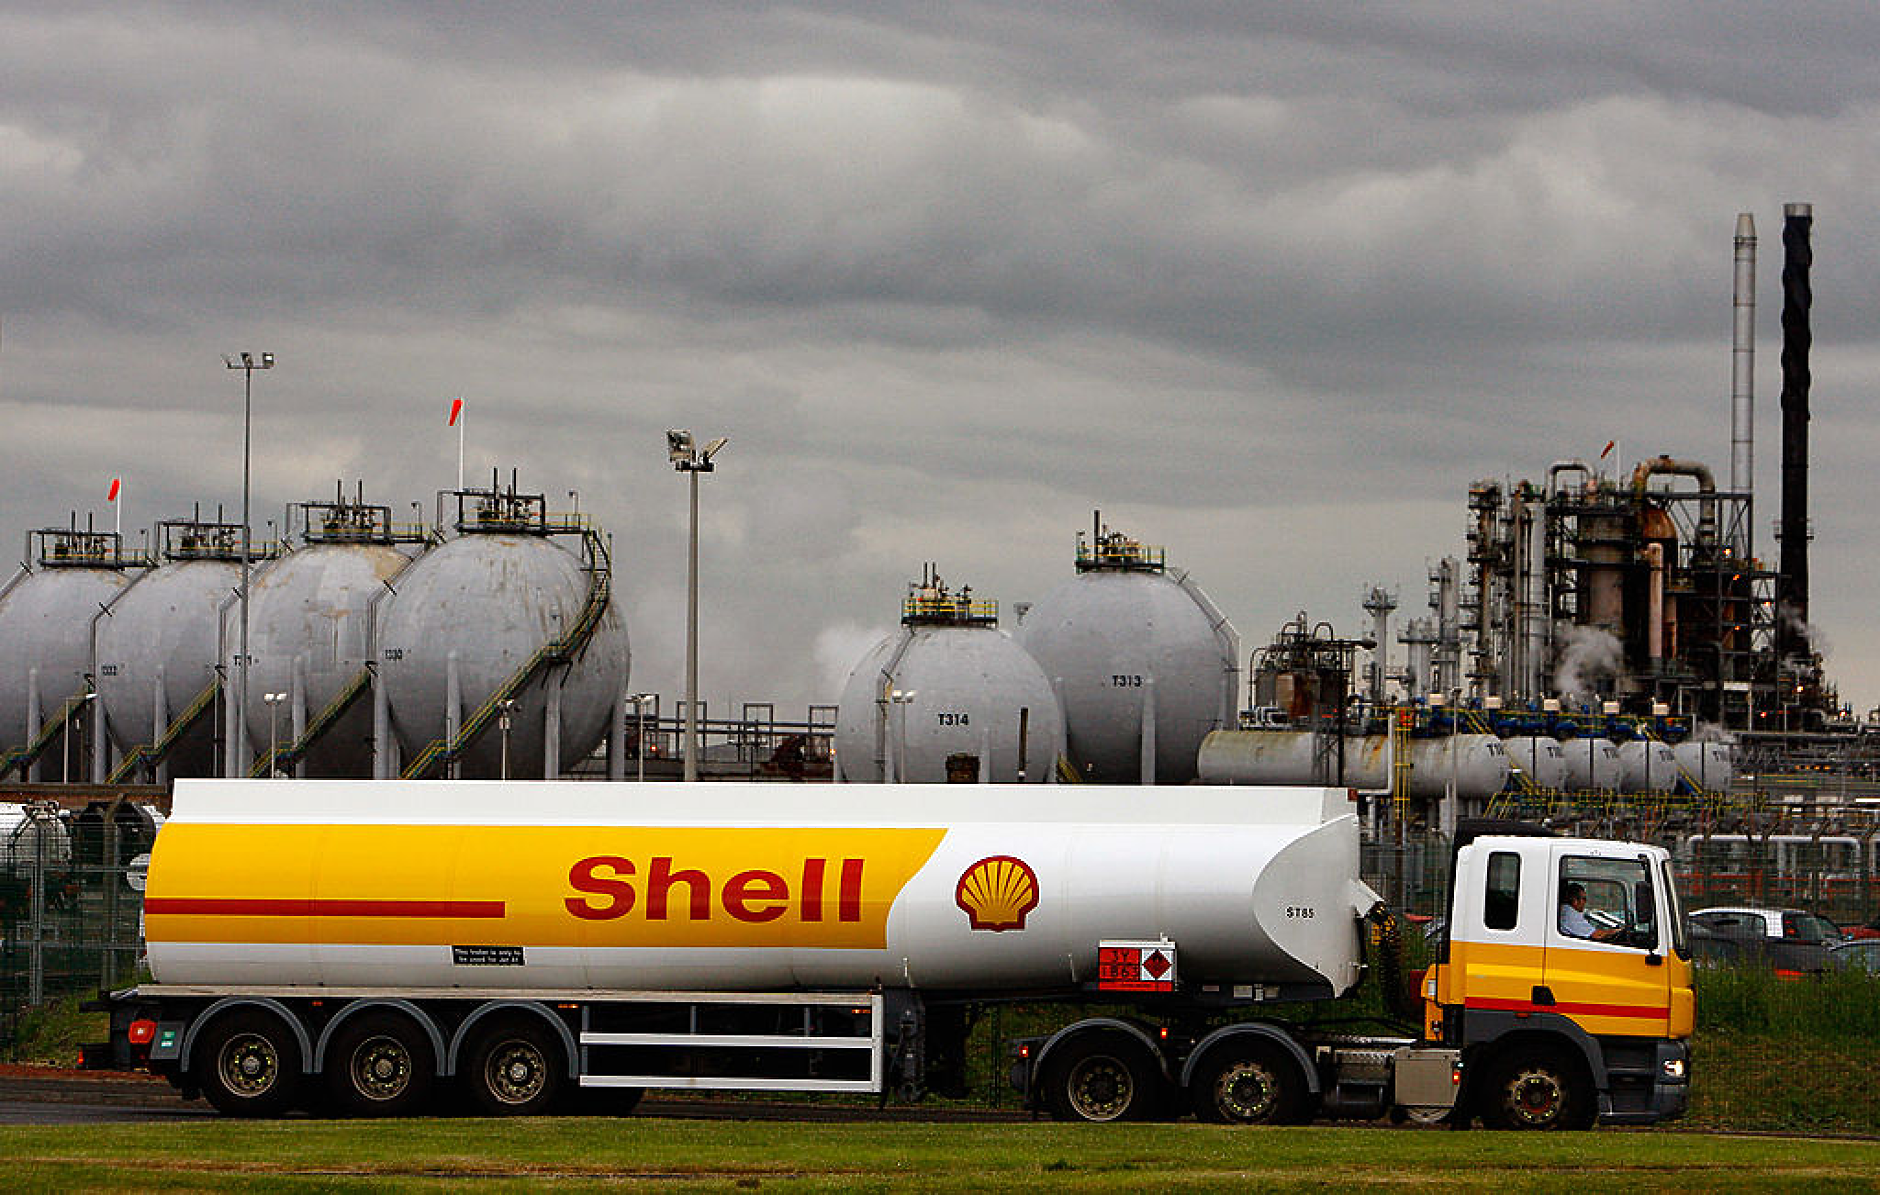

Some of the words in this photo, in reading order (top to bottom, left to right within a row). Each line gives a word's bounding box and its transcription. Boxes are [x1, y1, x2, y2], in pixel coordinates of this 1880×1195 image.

[1112, 675, 1141, 688] T313
[938, 713, 970, 726] T314
[565, 855, 865, 924] Shell
[1286, 906, 1315, 919] ST85
